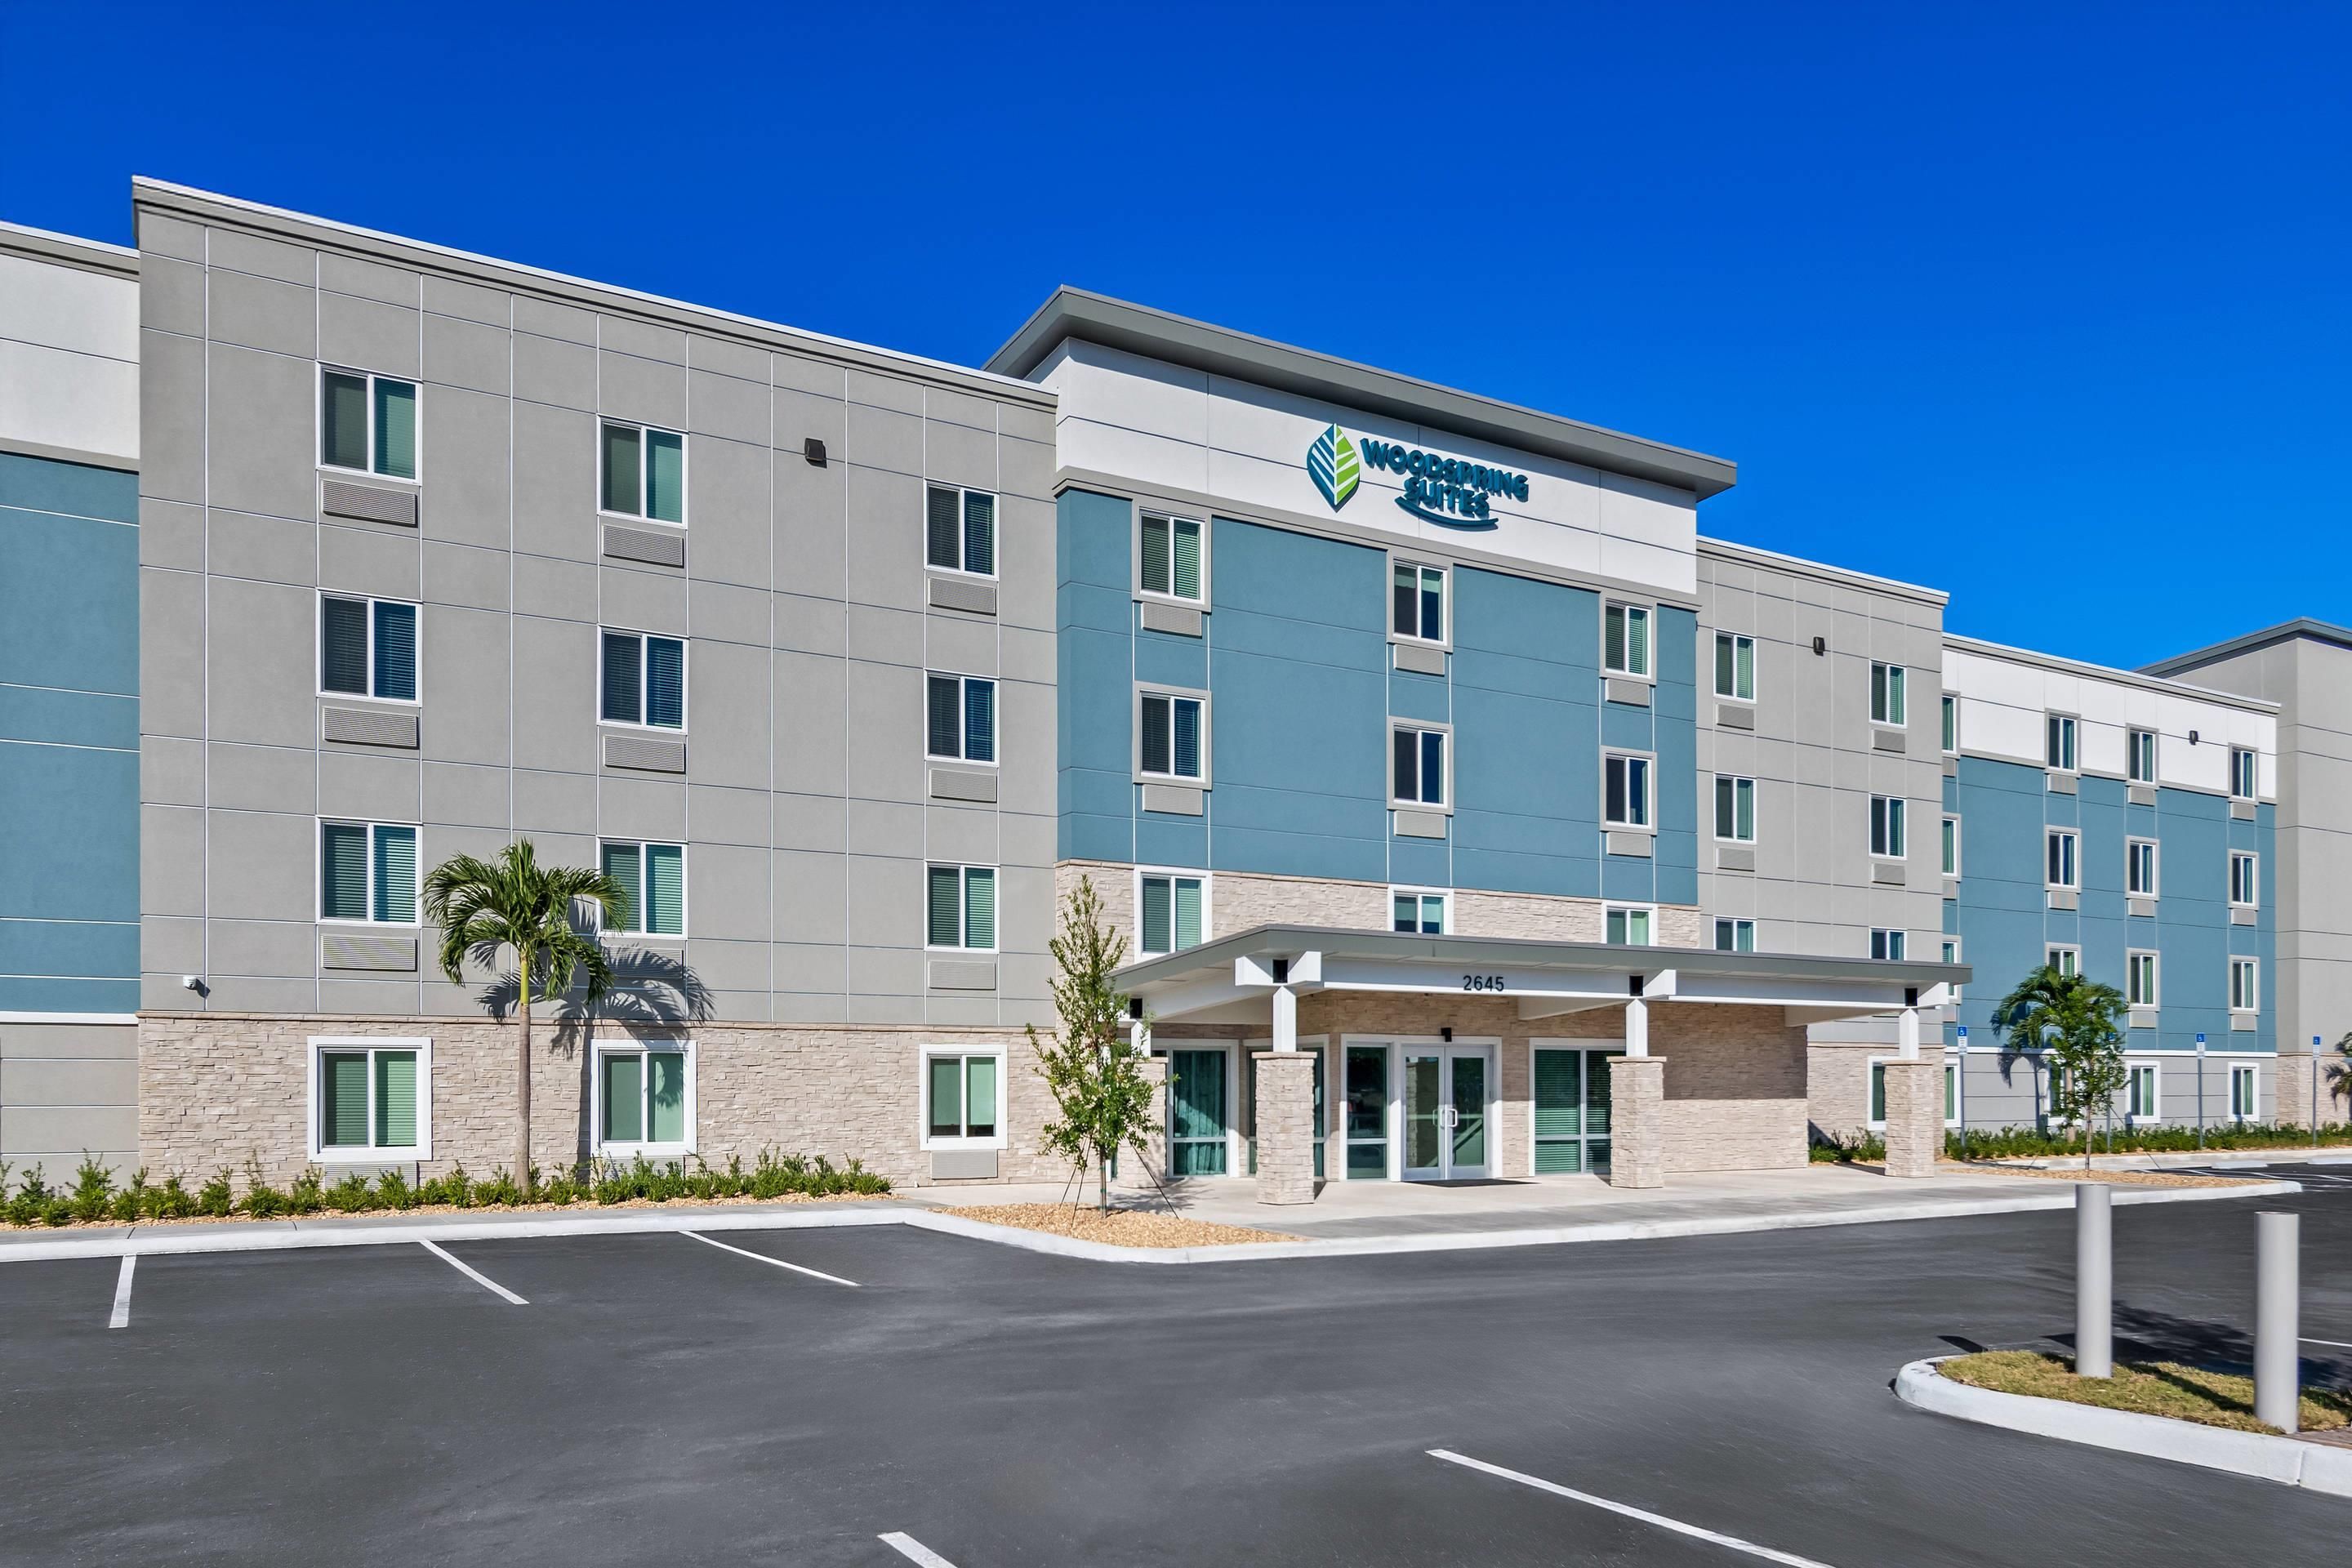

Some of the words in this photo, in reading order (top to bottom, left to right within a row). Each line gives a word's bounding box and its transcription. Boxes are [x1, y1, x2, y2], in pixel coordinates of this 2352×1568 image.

[1360, 438, 1529, 502] WOODSPRING
[1404, 476, 1490, 518] SUITES
[1463, 975, 1504, 991] 2645
